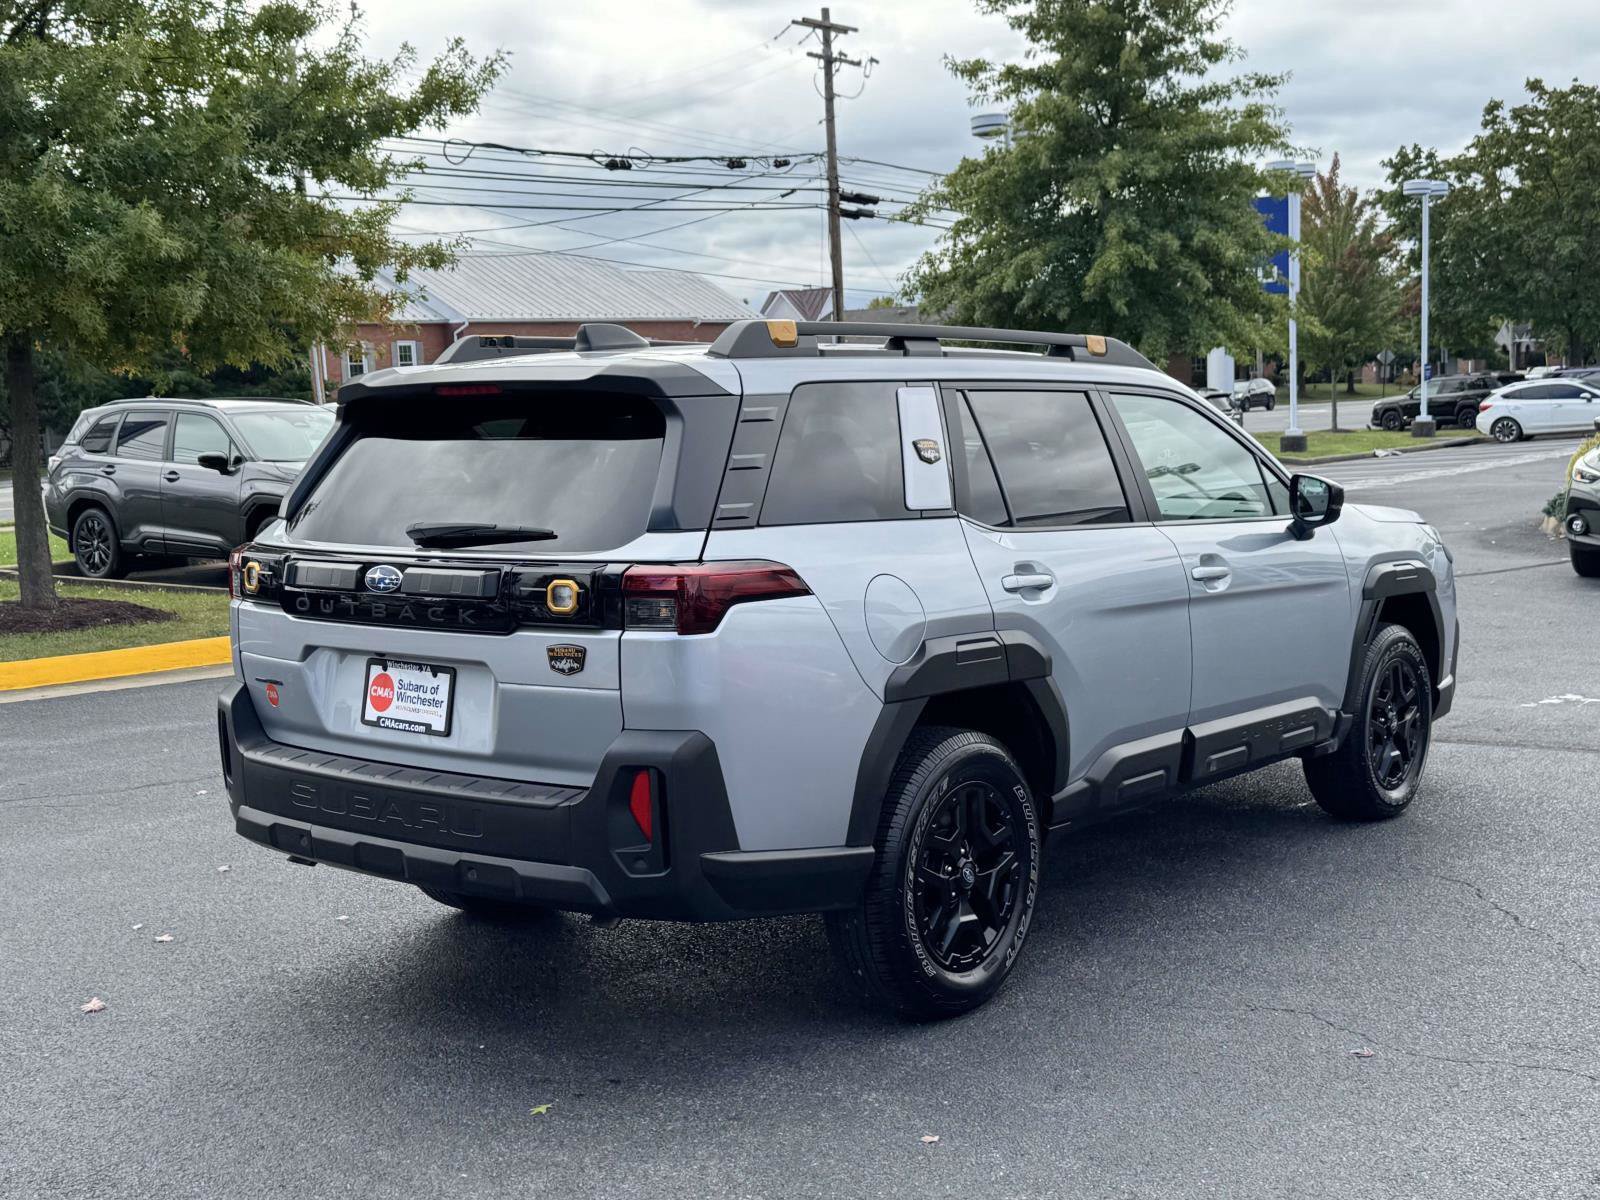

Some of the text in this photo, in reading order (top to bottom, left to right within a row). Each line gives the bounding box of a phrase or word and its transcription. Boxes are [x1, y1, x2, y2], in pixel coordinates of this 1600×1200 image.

[296, 597, 476, 625] OUTBACK
[422, 665, 431, 673] VA
[371, 686, 394, 698] CMA's
[398, 679, 440, 695] Subaru of
[396, 692, 444, 708] Winchester
[380, 718, 426, 732] CMAcars.com
[290, 781, 484, 838] SUBARU
